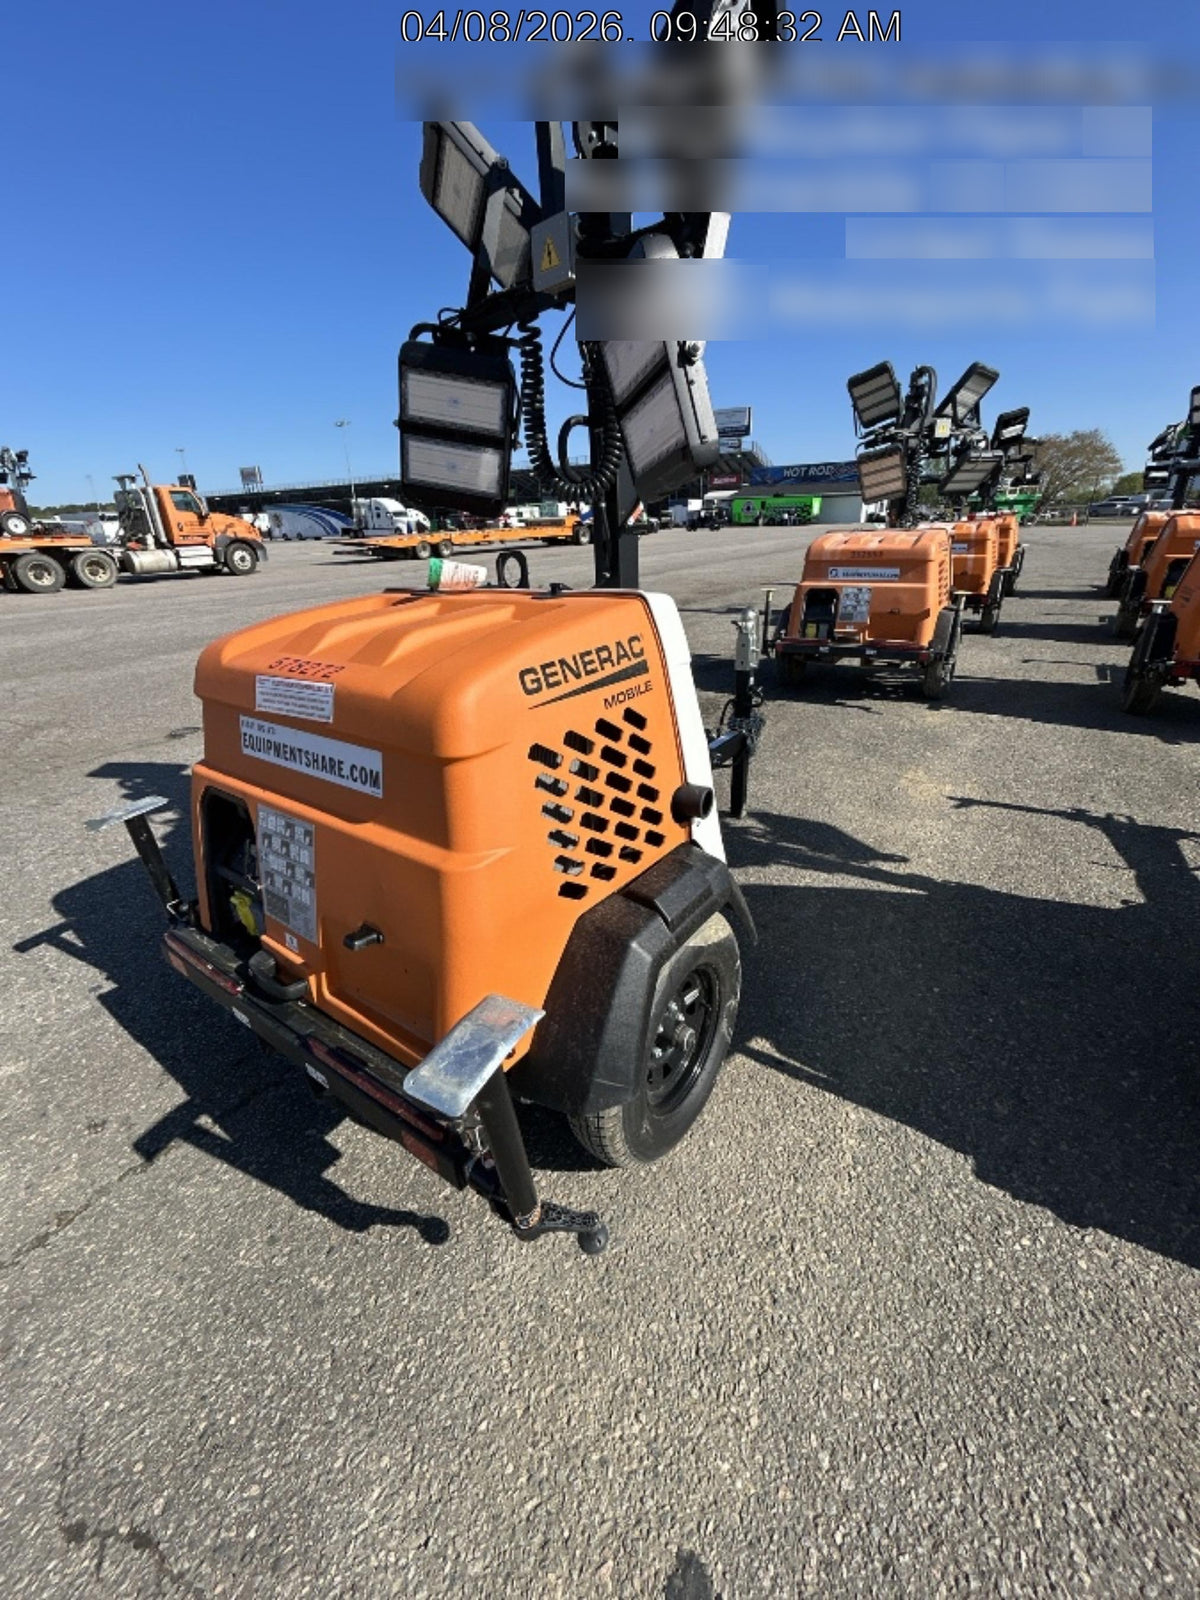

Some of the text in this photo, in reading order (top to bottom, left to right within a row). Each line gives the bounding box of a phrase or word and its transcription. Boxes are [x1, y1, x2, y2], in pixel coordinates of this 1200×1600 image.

[783, 467, 808, 478] HOT
[519, 635, 645, 696] GENERAC
[603, 680, 653, 709] MOBILE
[242, 731, 381, 790] EQUIPMENTSHARE.COM
